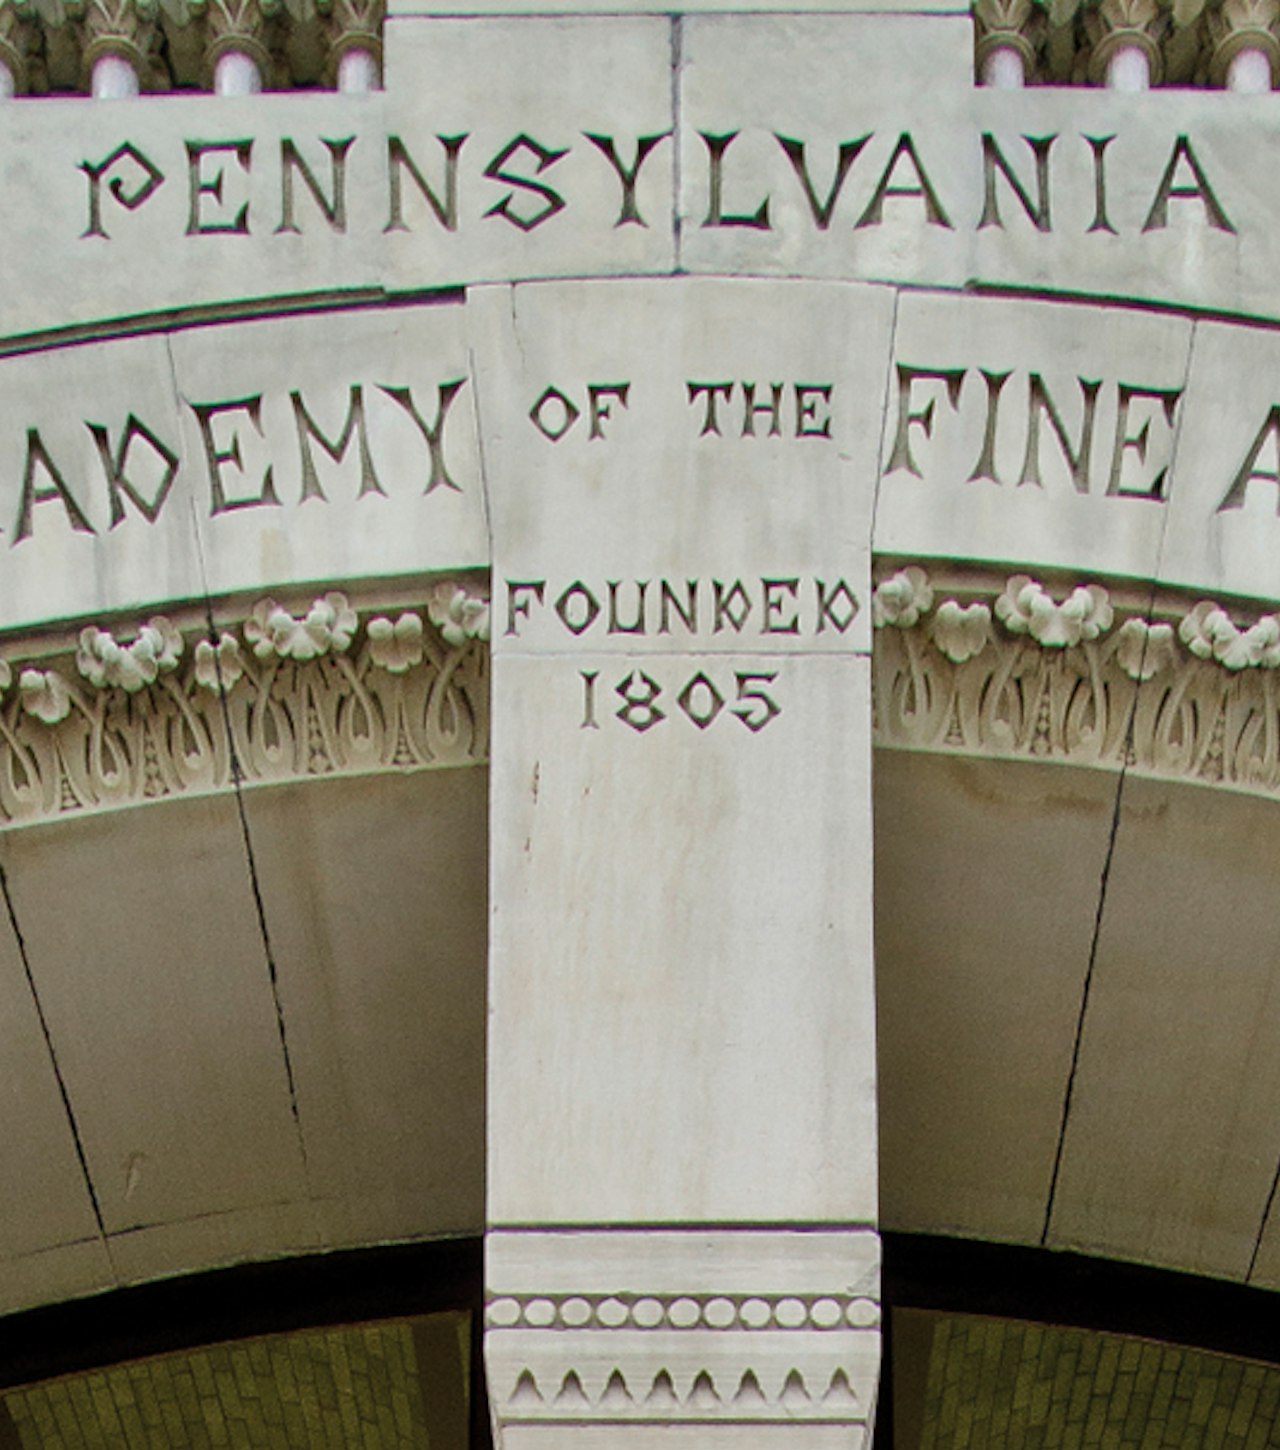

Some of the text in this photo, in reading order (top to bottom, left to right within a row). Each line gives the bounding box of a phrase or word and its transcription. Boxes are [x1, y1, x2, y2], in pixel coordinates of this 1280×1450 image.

[75, 131, 1238, 240] PENNSYLVANIA
[528, 380, 631, 443] OF
[686, 380, 834, 440] THE
[883, 362, 1186, 504] FINE
[502, 577, 861, 636] FOUNDED
[578, 670, 782, 733] 1805
